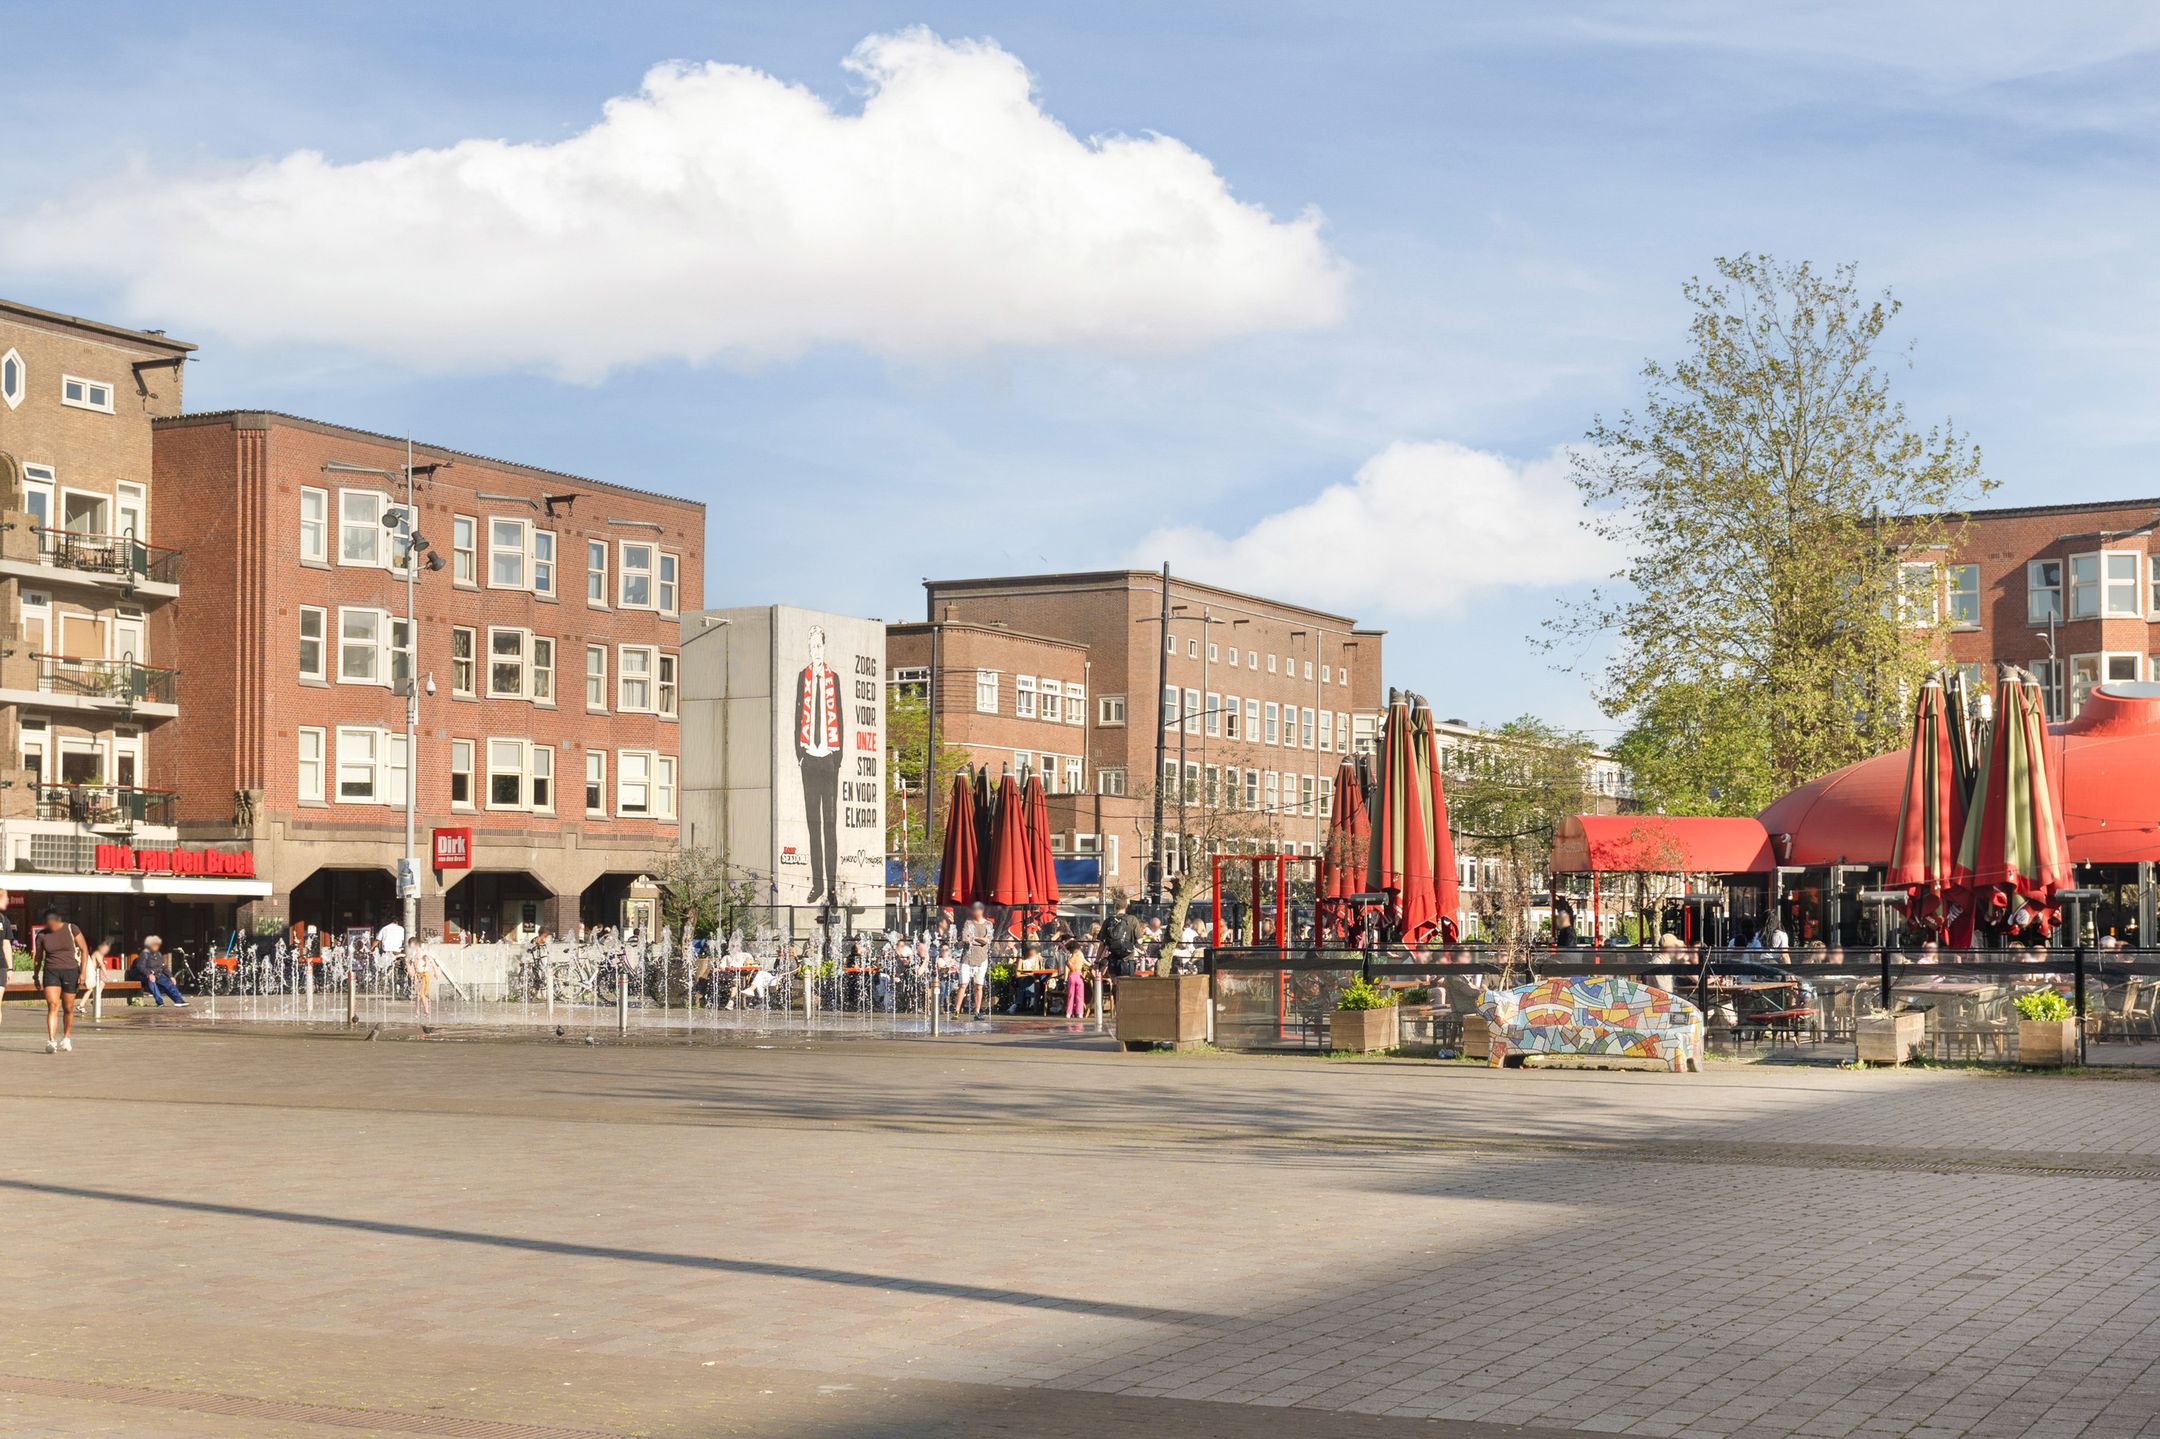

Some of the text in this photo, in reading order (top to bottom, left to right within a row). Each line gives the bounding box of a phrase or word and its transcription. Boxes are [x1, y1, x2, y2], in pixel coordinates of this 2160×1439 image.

[855, 655, 876, 677] ZORG
[855, 680, 876, 702] GOED
[801, 678, 811, 741] AJAX
[855, 704, 876, 726] VOOR
[857, 731, 877, 752] ONZE
[857, 756, 876, 777] STAD
[843, 781, 877, 803] EN VOOR
[845, 807, 877, 828] ELKAAR
[438, 835, 466, 853] Dirk
[96, 844, 255, 875] Dirk van den Broek
